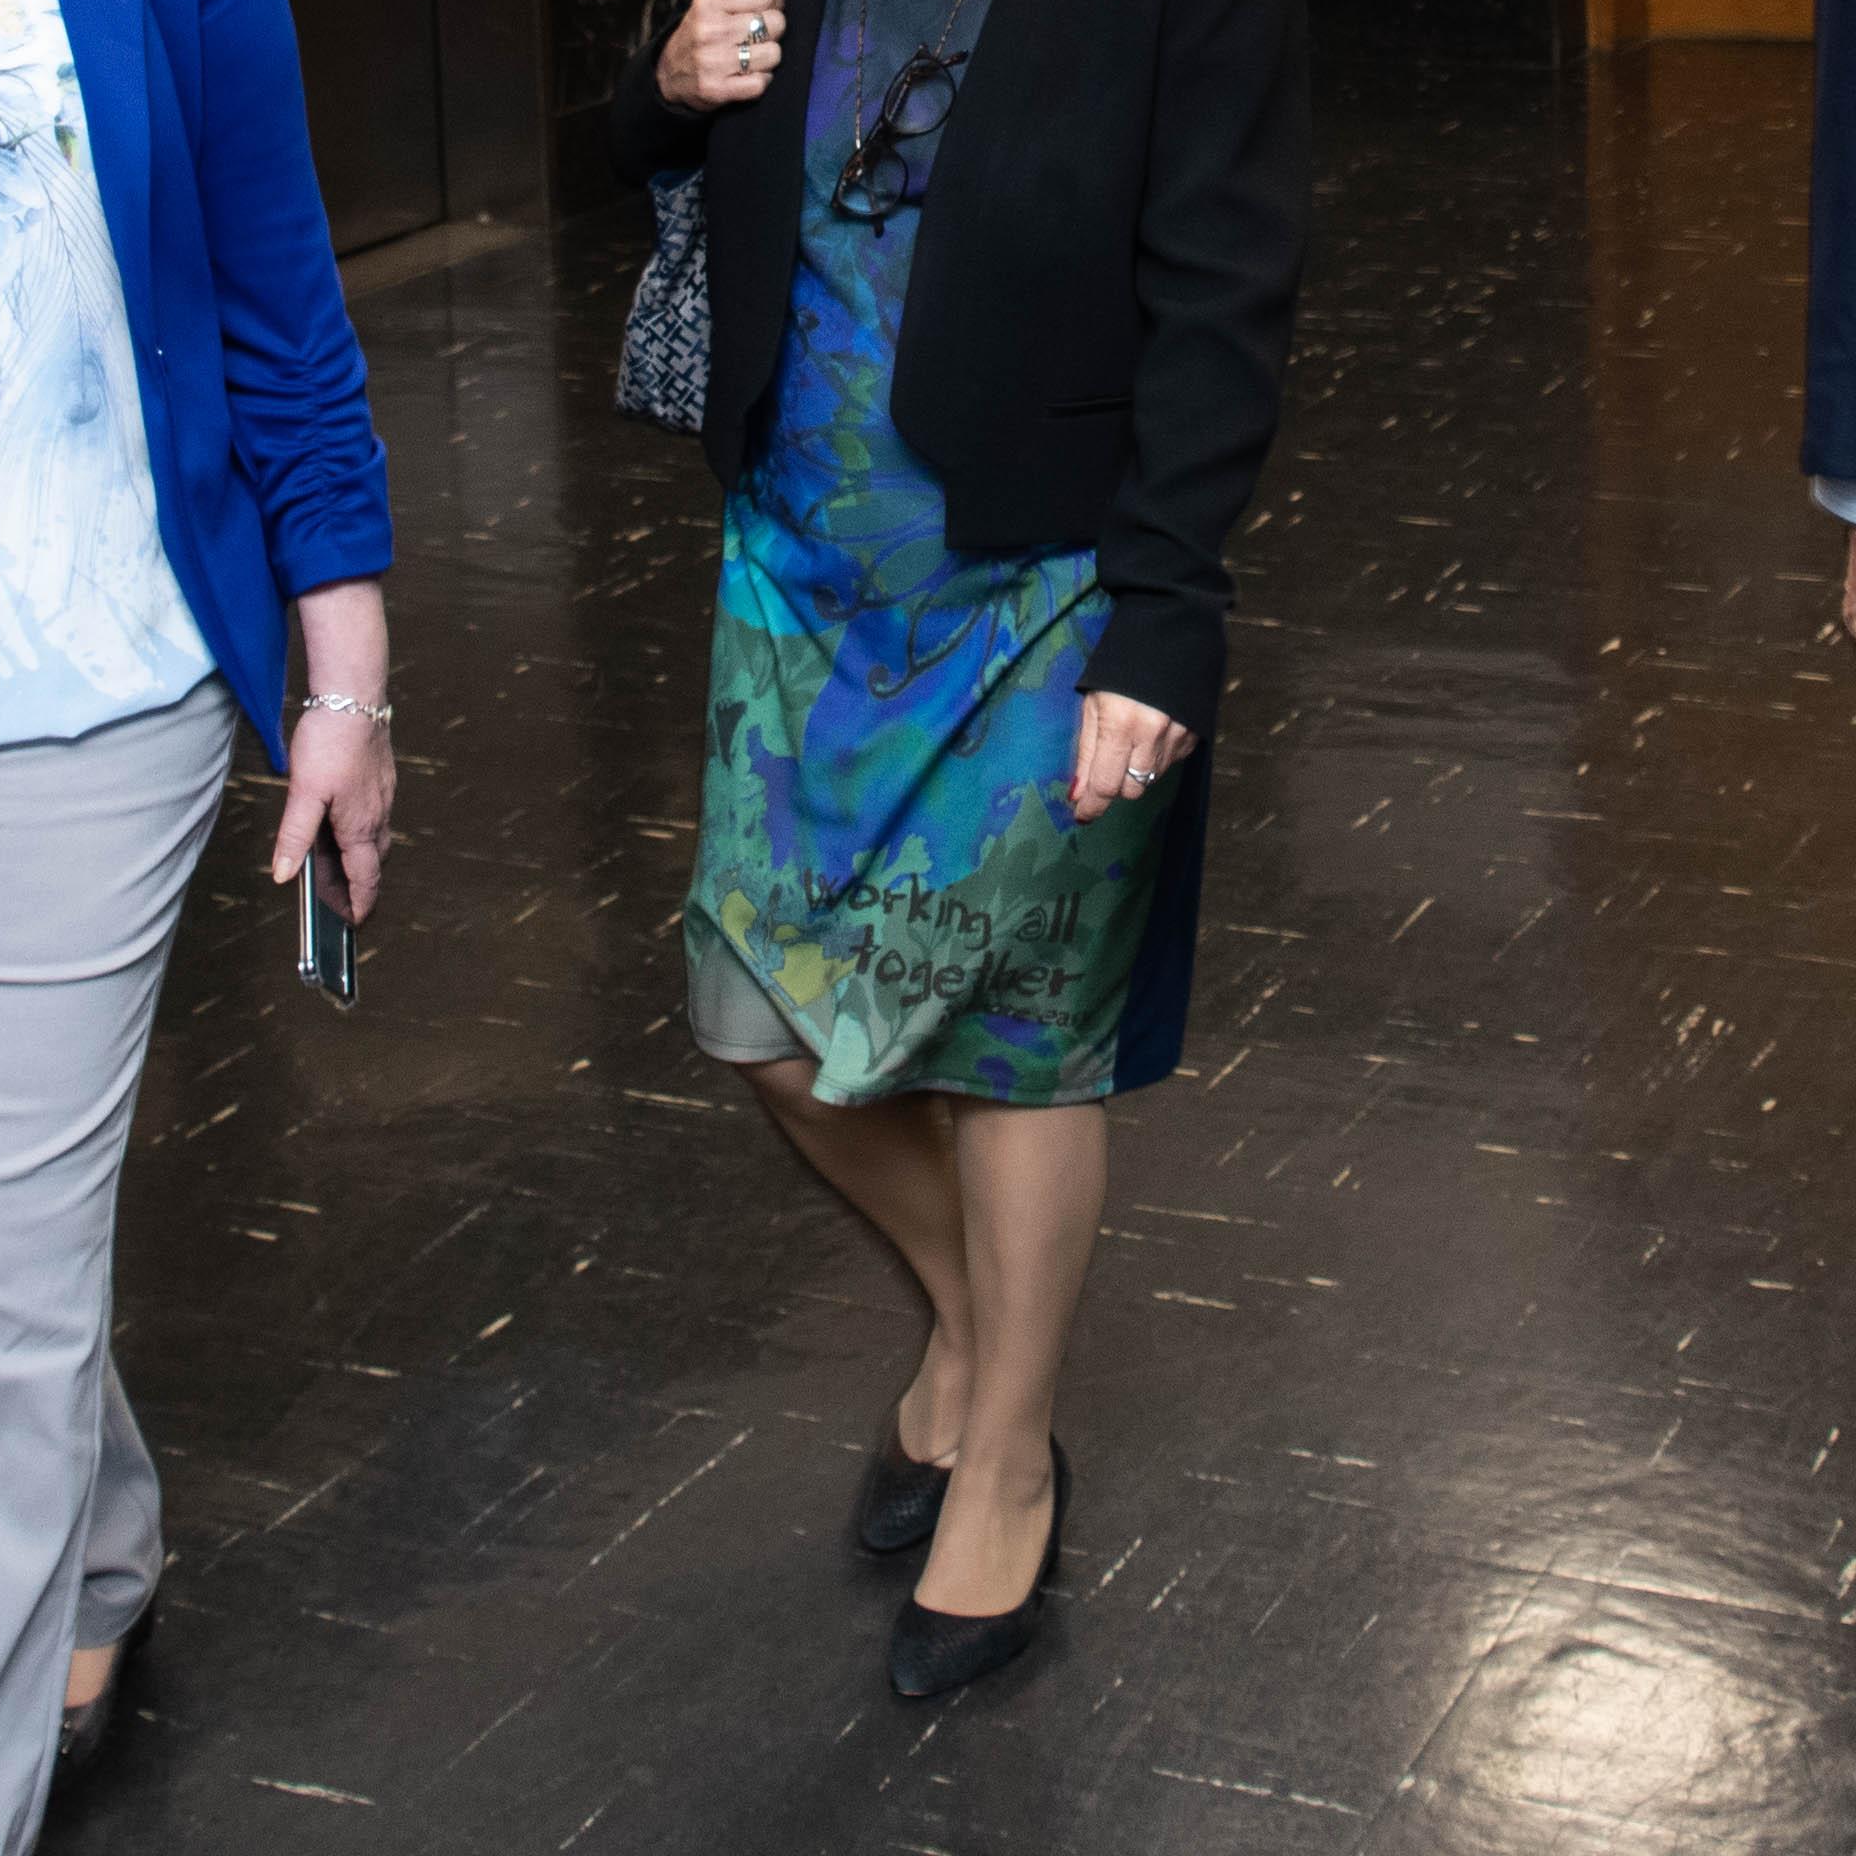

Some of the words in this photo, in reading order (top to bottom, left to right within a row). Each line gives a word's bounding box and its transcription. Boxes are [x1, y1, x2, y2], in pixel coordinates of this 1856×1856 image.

[803, 867, 992, 948] Working
[1016, 892, 1082, 943] all
[855, 924, 1085, 1008] together
